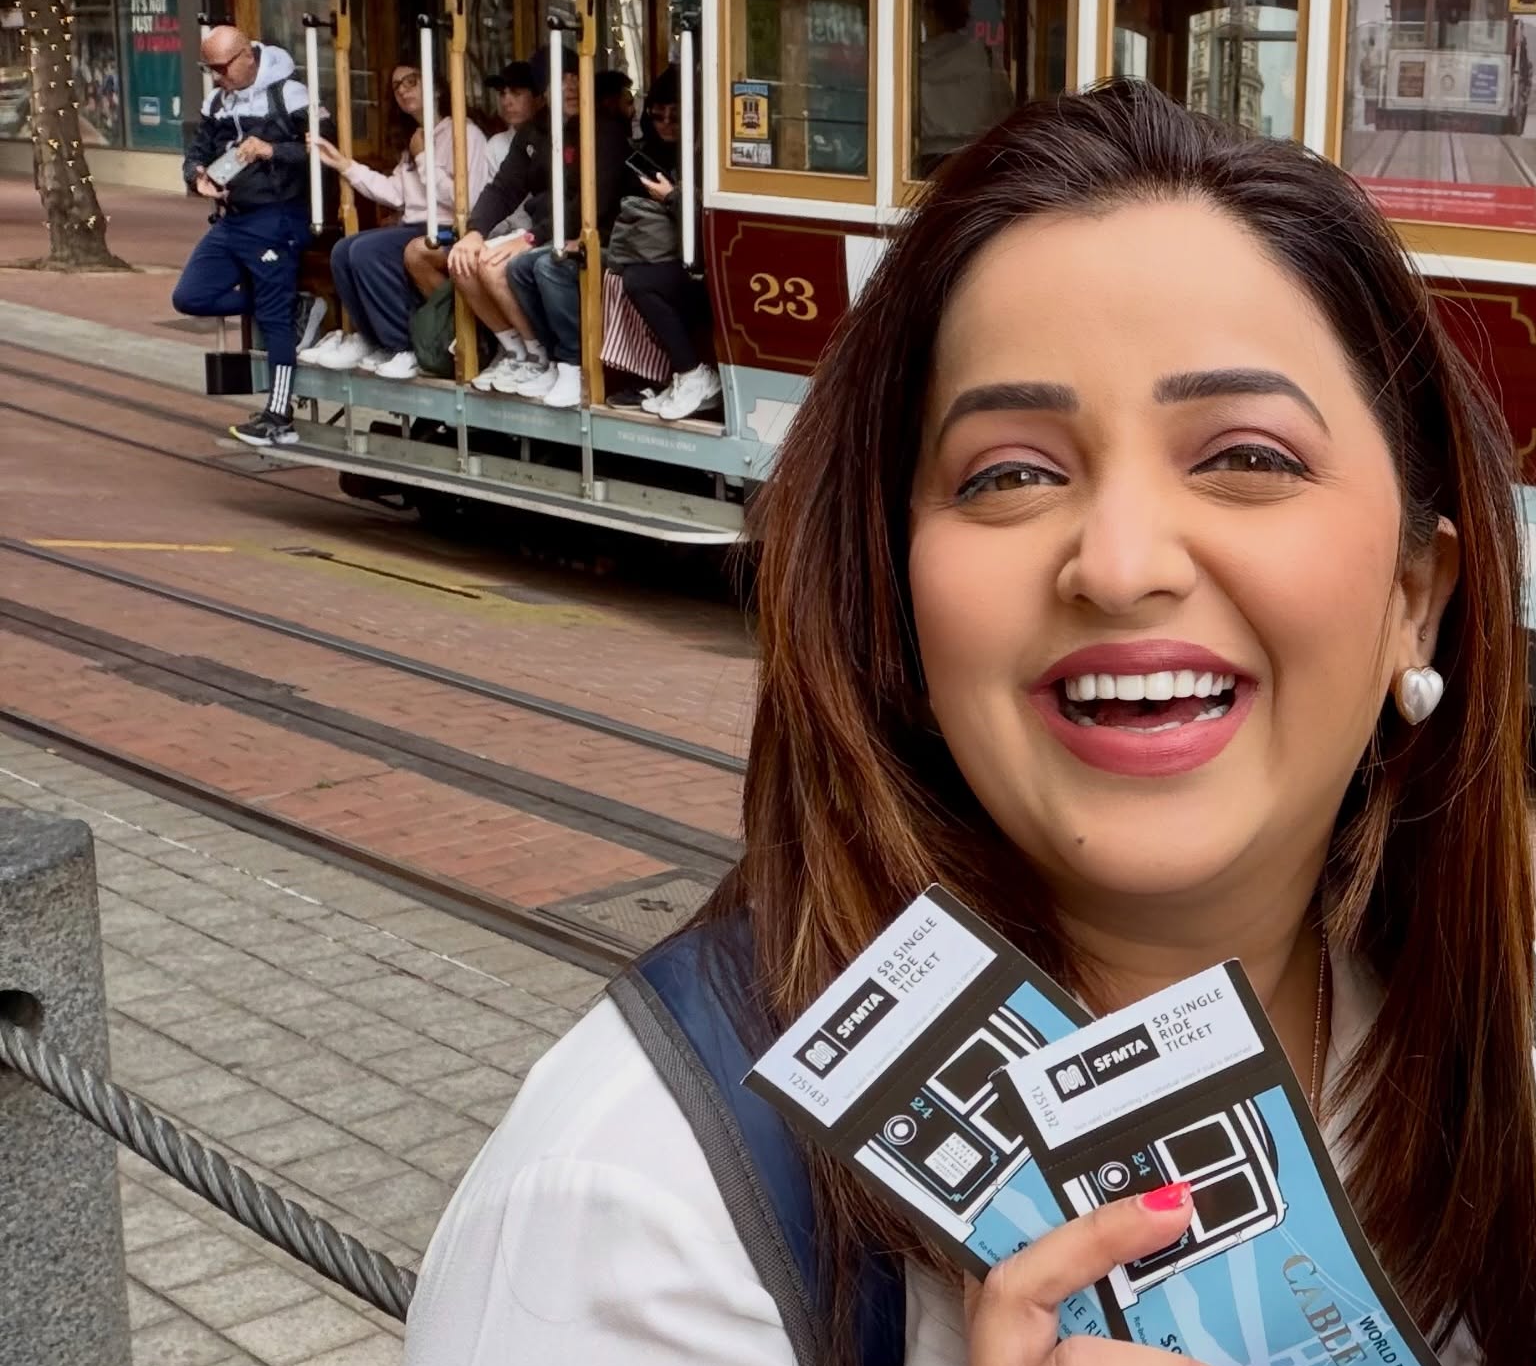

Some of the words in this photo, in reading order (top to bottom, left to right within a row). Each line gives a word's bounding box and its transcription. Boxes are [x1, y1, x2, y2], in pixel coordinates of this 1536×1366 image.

[749, 272, 819, 321] 23
[893, 917, 938, 961] SINGLE
[888, 955, 919, 985] RIDE
[897, 951, 941, 993] TICKET
[836, 992, 885, 1039] SFMTA
[1173, 988, 1224, 1020] SINGLE
[1159, 1019, 1193, 1041] RIDE
[1165, 1022, 1214, 1053] TICKET
[1093, 1038, 1149, 1073] SFMTA
[910, 1096, 934, 1120] 24
[1132, 1151, 1152, 1177] 24
[1359, 1315, 1397, 1365] WORLD
